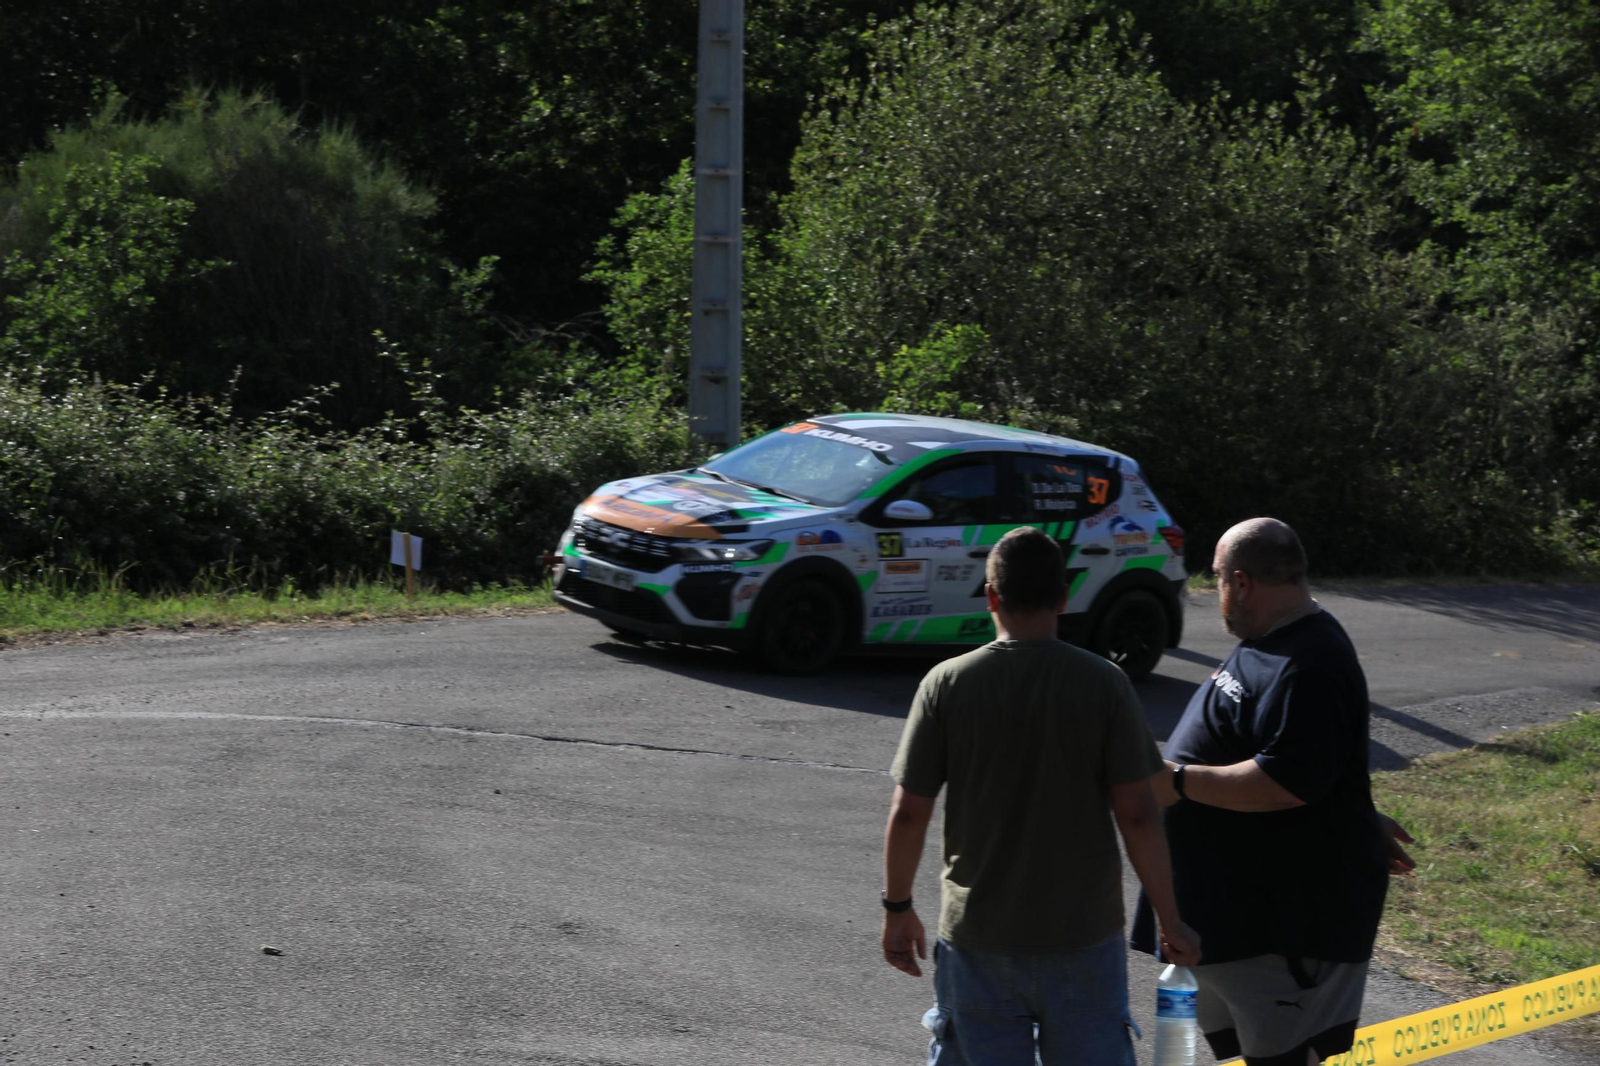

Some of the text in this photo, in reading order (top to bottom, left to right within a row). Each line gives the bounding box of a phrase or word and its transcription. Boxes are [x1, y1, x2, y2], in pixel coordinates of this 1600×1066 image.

[804, 428, 894, 452] KUMHO
[1086, 476, 1110, 505] 37
[878, 534, 901, 556] 37
